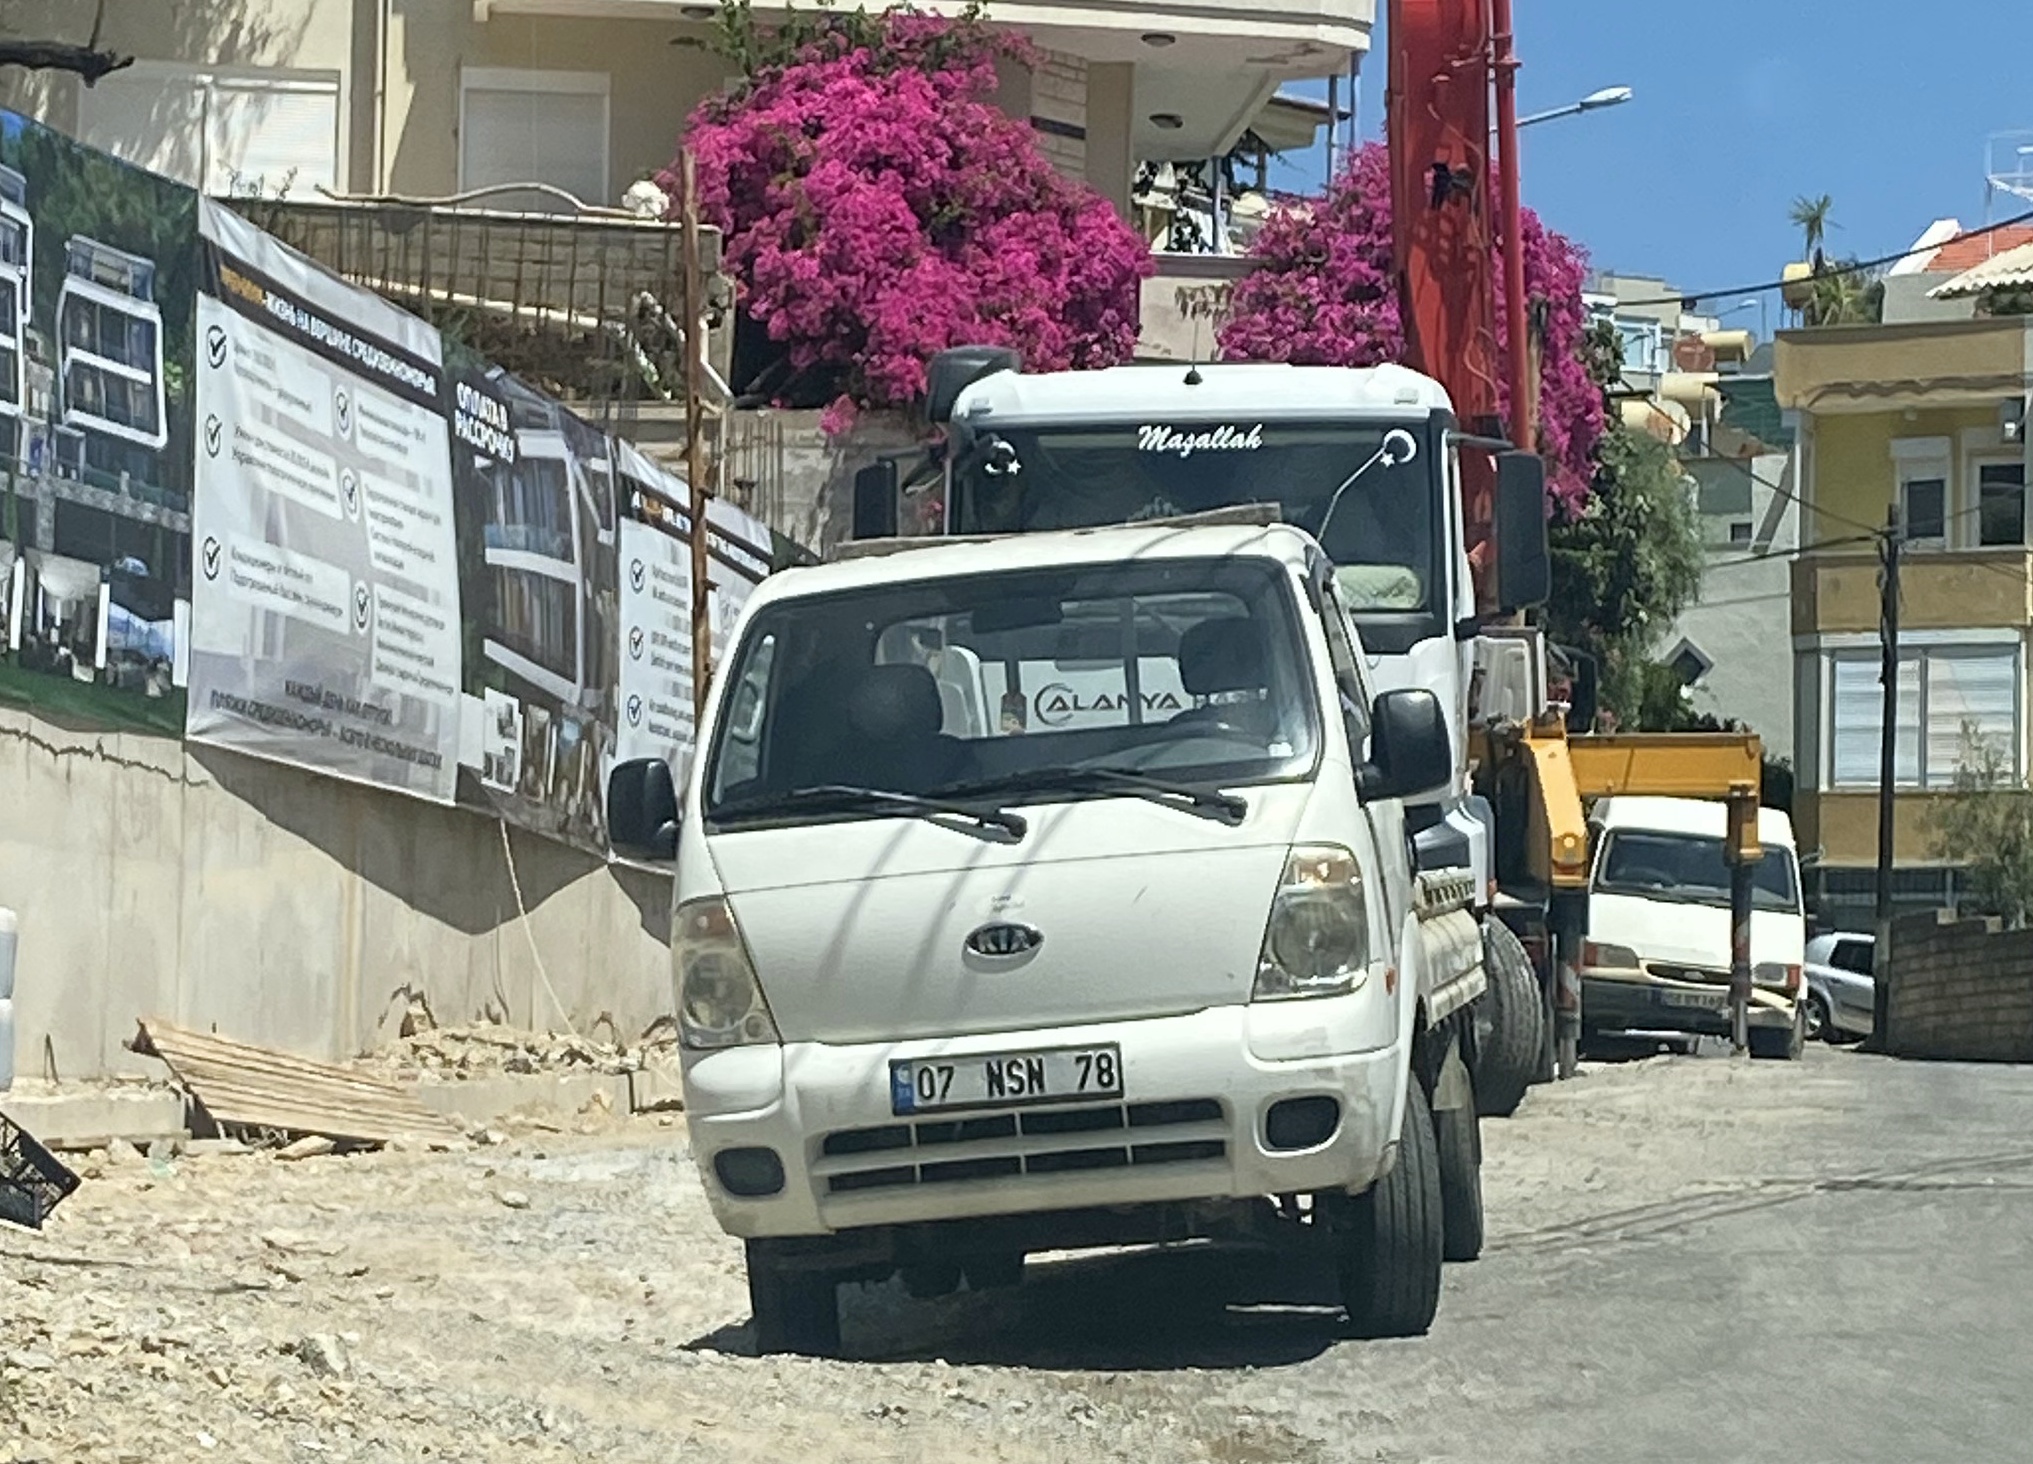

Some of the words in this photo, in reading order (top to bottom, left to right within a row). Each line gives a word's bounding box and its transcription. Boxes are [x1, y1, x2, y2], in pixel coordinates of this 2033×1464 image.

[917, 1065, 955, 1102] 07
[986, 1056, 1046, 1098] NSN
[1075, 1052, 1115, 1091] 78
